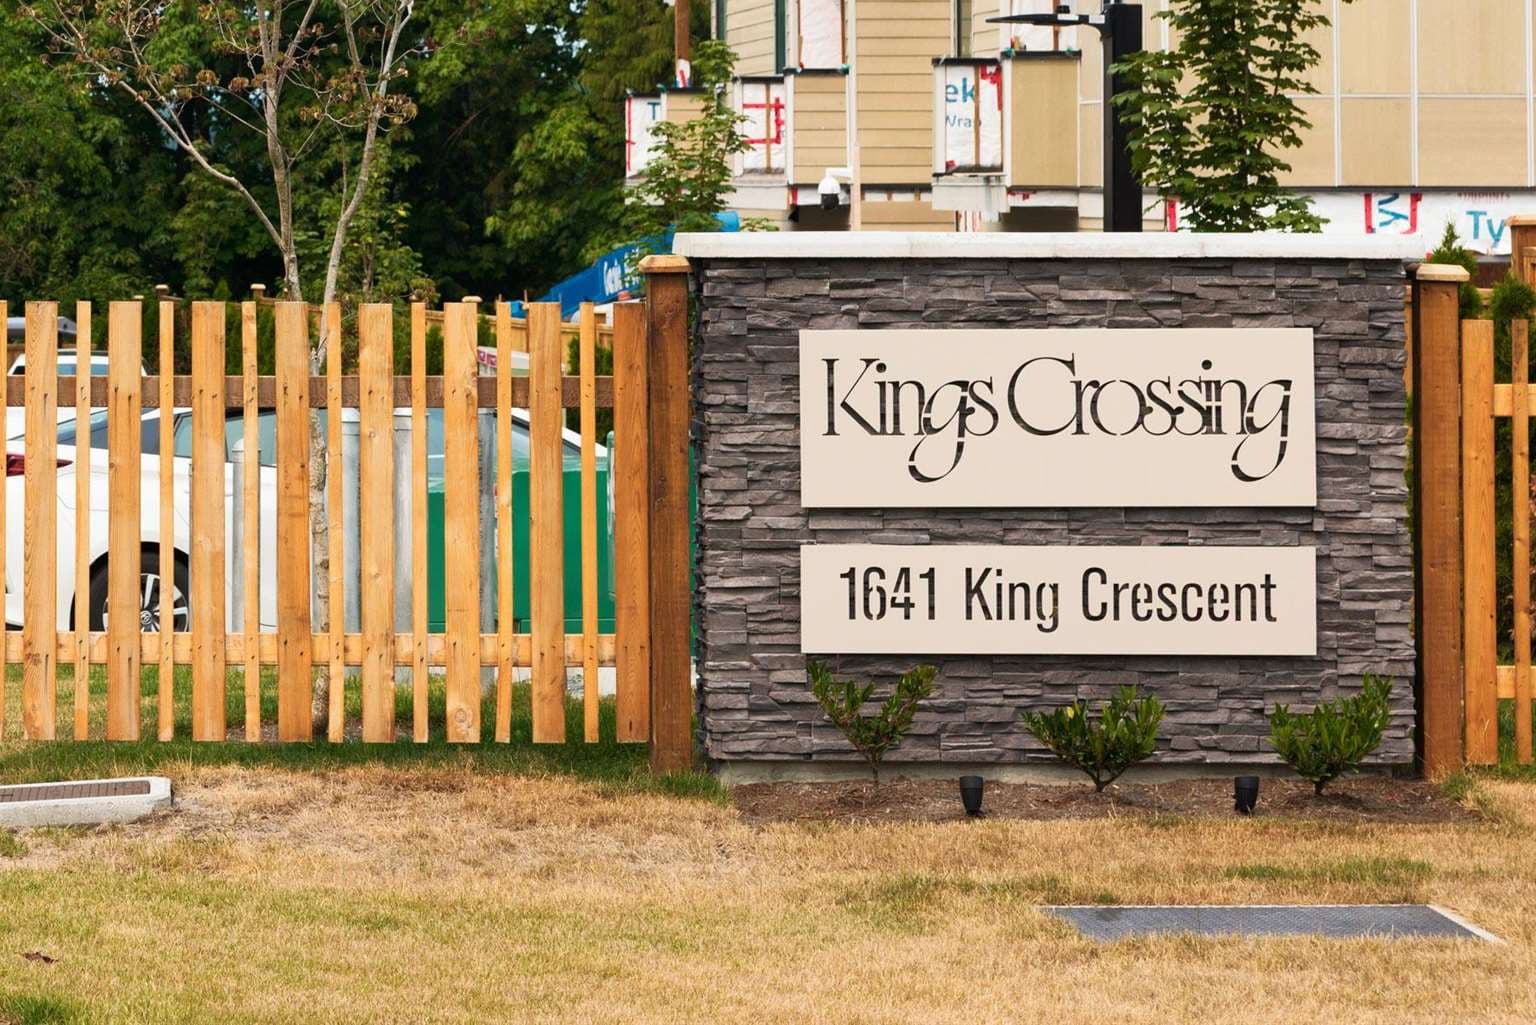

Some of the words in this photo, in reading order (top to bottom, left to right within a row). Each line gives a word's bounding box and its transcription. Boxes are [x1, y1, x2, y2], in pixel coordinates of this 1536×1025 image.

[1465, 210, 1506, 248] Ty
[839, 566, 936, 621] 1641
[965, 567, 1059, 634] King
[1081, 566, 1277, 623] Crescent
